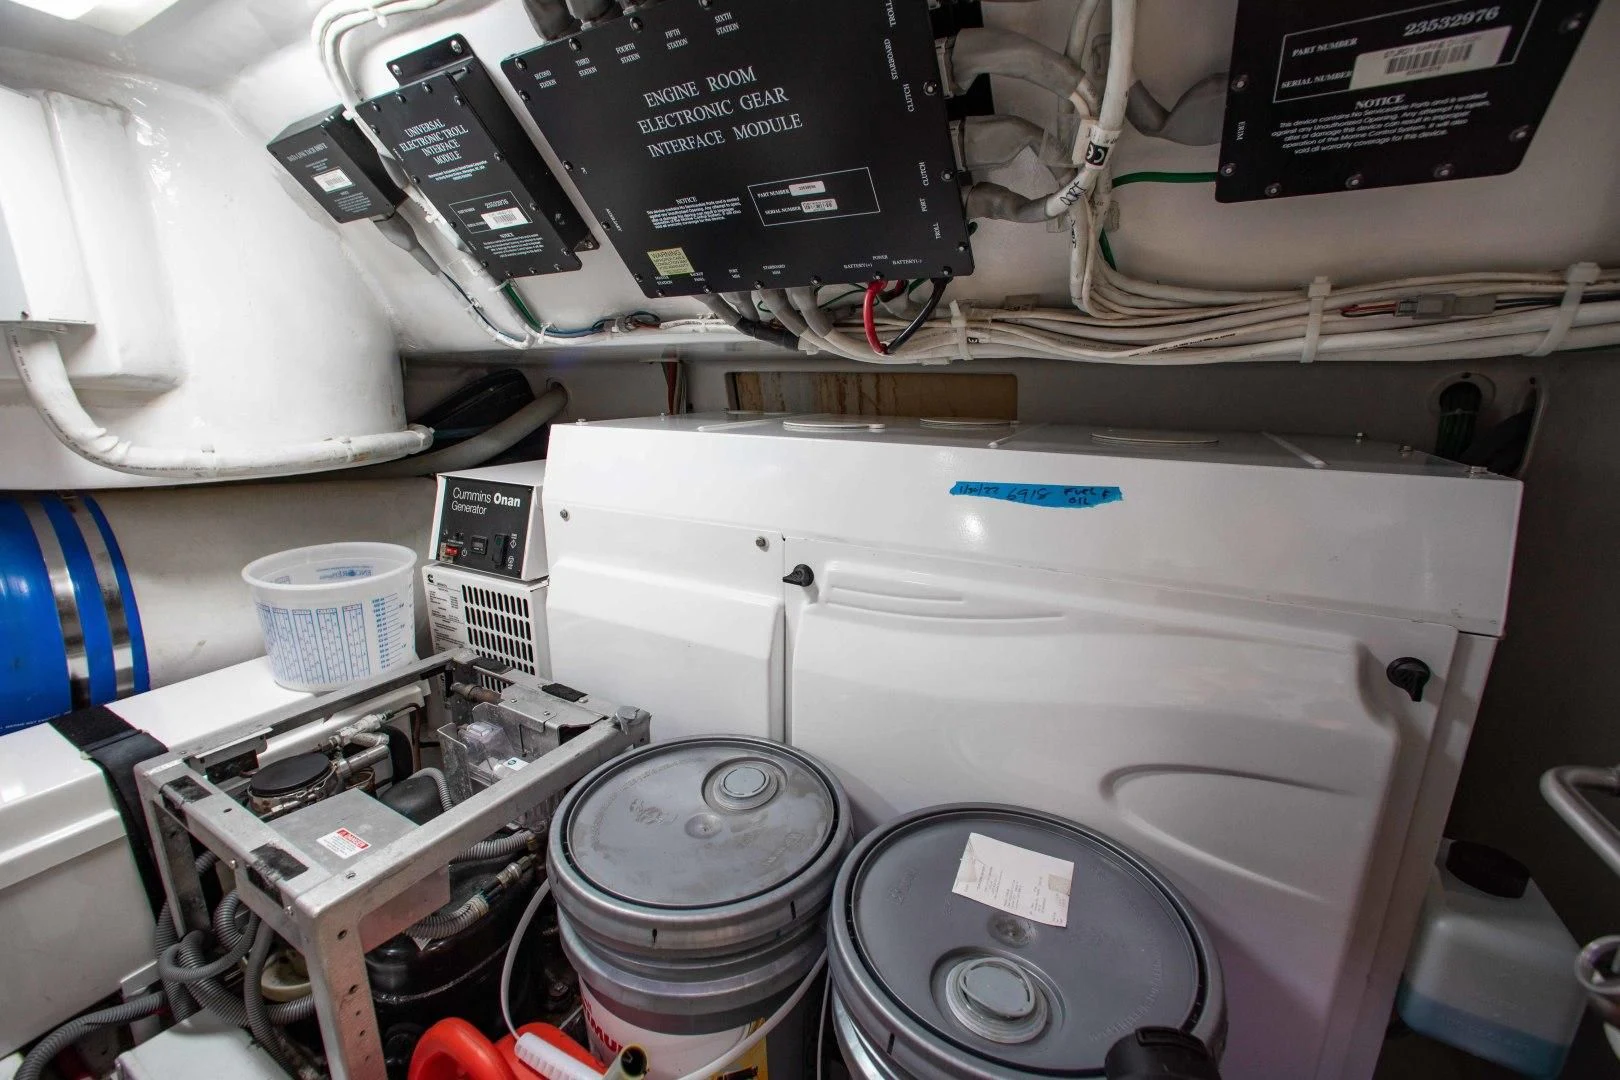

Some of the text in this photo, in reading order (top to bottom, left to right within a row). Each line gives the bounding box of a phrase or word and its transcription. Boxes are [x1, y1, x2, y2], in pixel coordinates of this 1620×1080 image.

[714, 12, 732, 24] SIXTH
[665, 28, 680, 39] FIFTH
[716, 22, 739, 36] STATION
[1292, 6, 1500, 58] PART NUMBER 23532976
[616, 43, 635, 54] FOURTH
[667, 38, 688, 50] STATION
[620, 53, 640, 64] STATION
[884, 39, 898, 80] STARBOARD
[578, 66, 597, 76] STATION
[539, 79, 557, 89] STATION
[643, 65, 758, 108] ENGINE ROOM
[1281, 78, 1312, 89] SERIAL
[903, 83, 914, 112] CLUTCH
[1355, 93, 1405, 110] NOTICE
[637, 87, 789, 134] ELECTRONIC GEAR
[1319, 114, 1351, 122] contains
[1364, 104, 1409, 116] Serviceable
[404, 118, 445, 137] UNIVERSAL
[1271, 128, 1298, 137] against
[1310, 129, 1342, 138] damage
[1356, 123, 1383, 131] device
[399, 125, 469, 152] ELECTRONIC TROLL
[647, 113, 803, 158] INTERFACE MODULE
[422, 139, 460, 157] INTERFACE
[1283, 140, 1316, 148] operation
[1321, 142, 1353, 151] warranty
[433, 151, 462, 165] MODULE
[919, 162, 929, 186] CLUTCH
[676, 196, 697, 204] NOTICE
[453, 487, 521, 507] Cummins Onan
[452, 500, 487, 515] Generator
